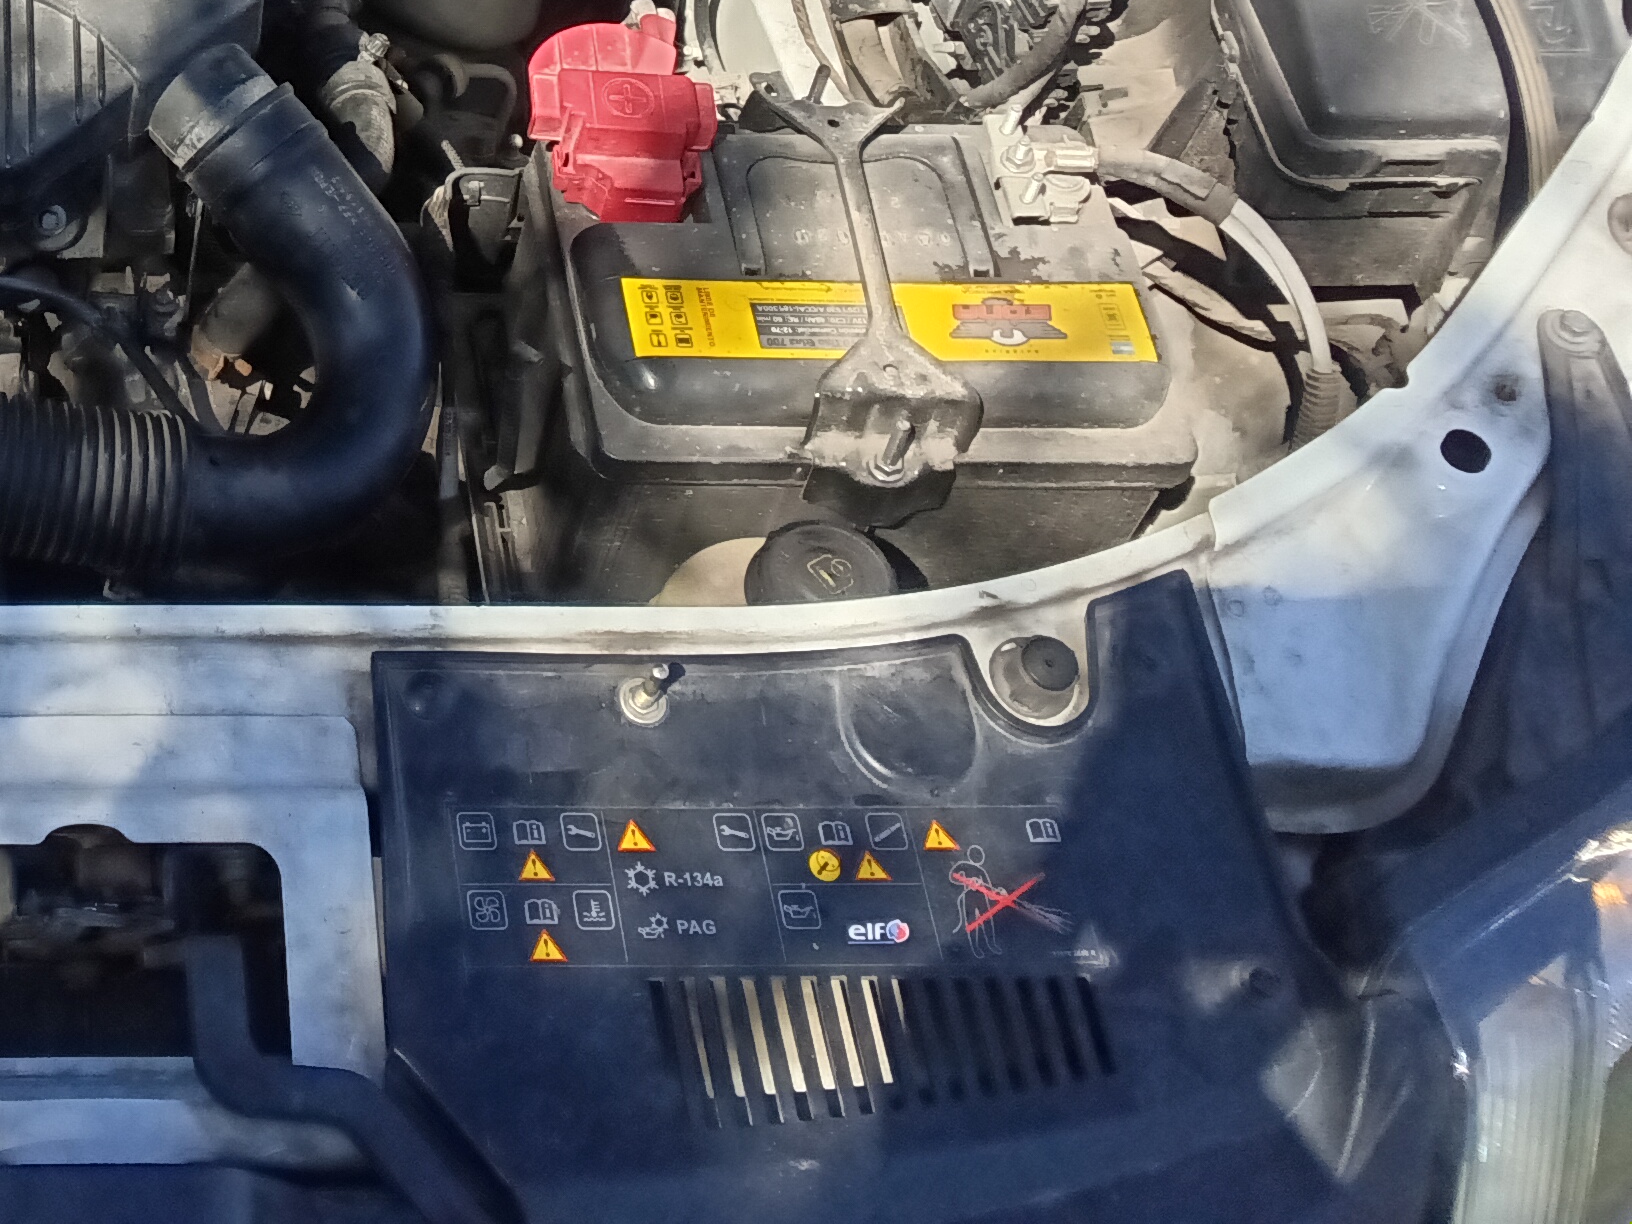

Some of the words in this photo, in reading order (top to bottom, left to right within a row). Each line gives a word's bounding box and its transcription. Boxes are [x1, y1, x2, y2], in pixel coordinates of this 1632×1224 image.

[663, 871, 723, 887] R-134a
[676, 919, 716, 935] PAG
[847, 922, 886, 941] elf
